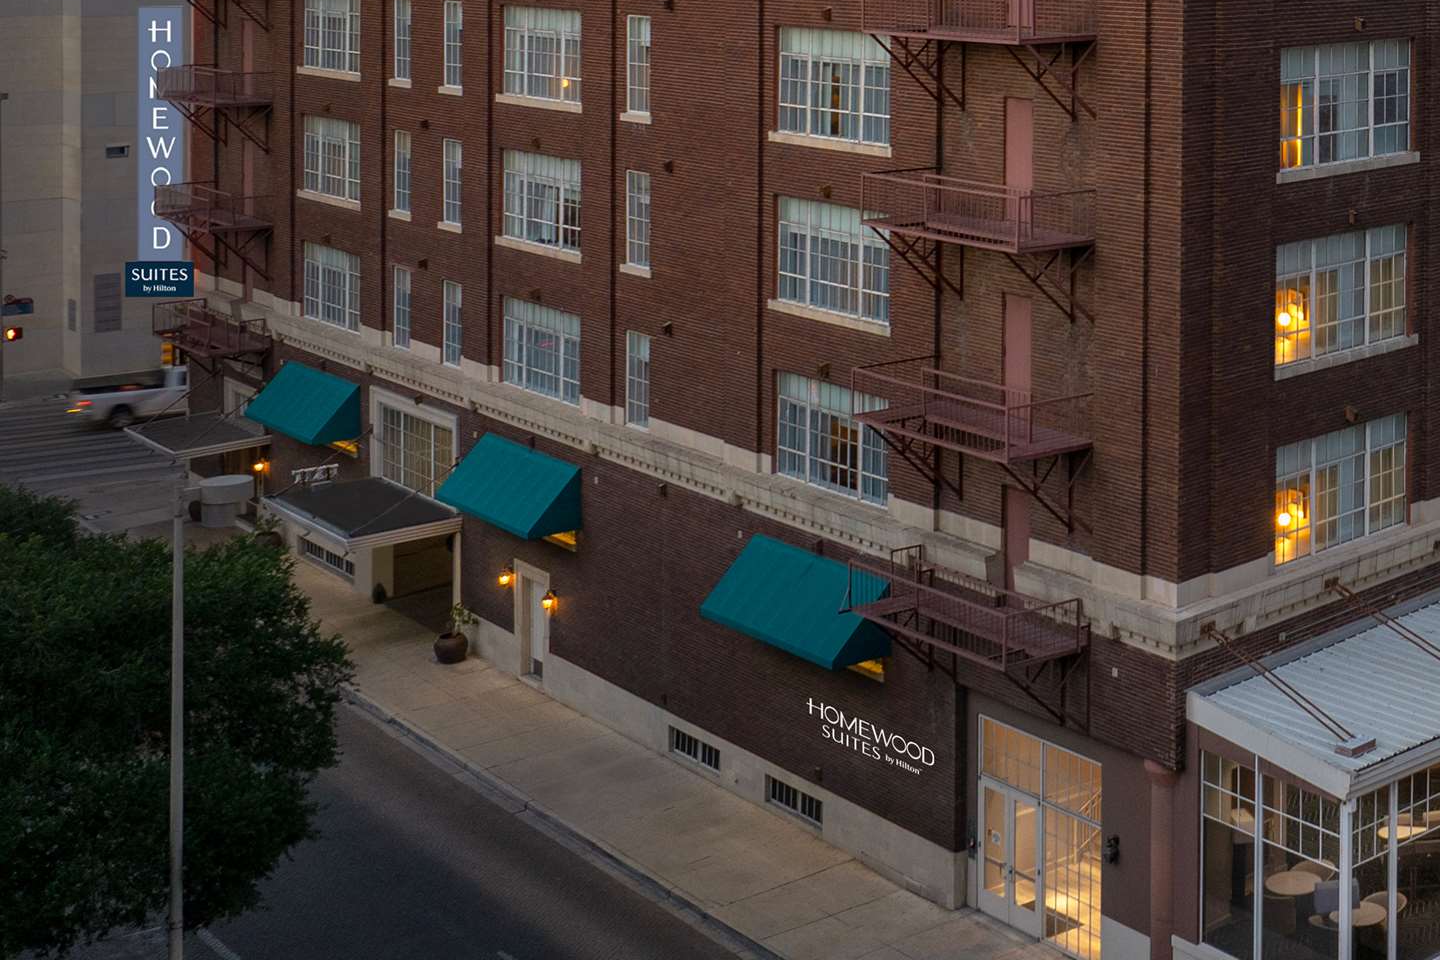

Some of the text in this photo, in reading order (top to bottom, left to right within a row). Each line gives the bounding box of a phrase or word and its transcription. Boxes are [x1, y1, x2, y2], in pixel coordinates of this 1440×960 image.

[146, 20, 176, 250] HOEWOD
[131, 268, 189, 281] SUITES
[143, 285, 152, 294] by
[806, 697, 935, 766] HOMEWOOD
[822, 724, 881, 760] SUITES
[885, 753, 895, 765] by
